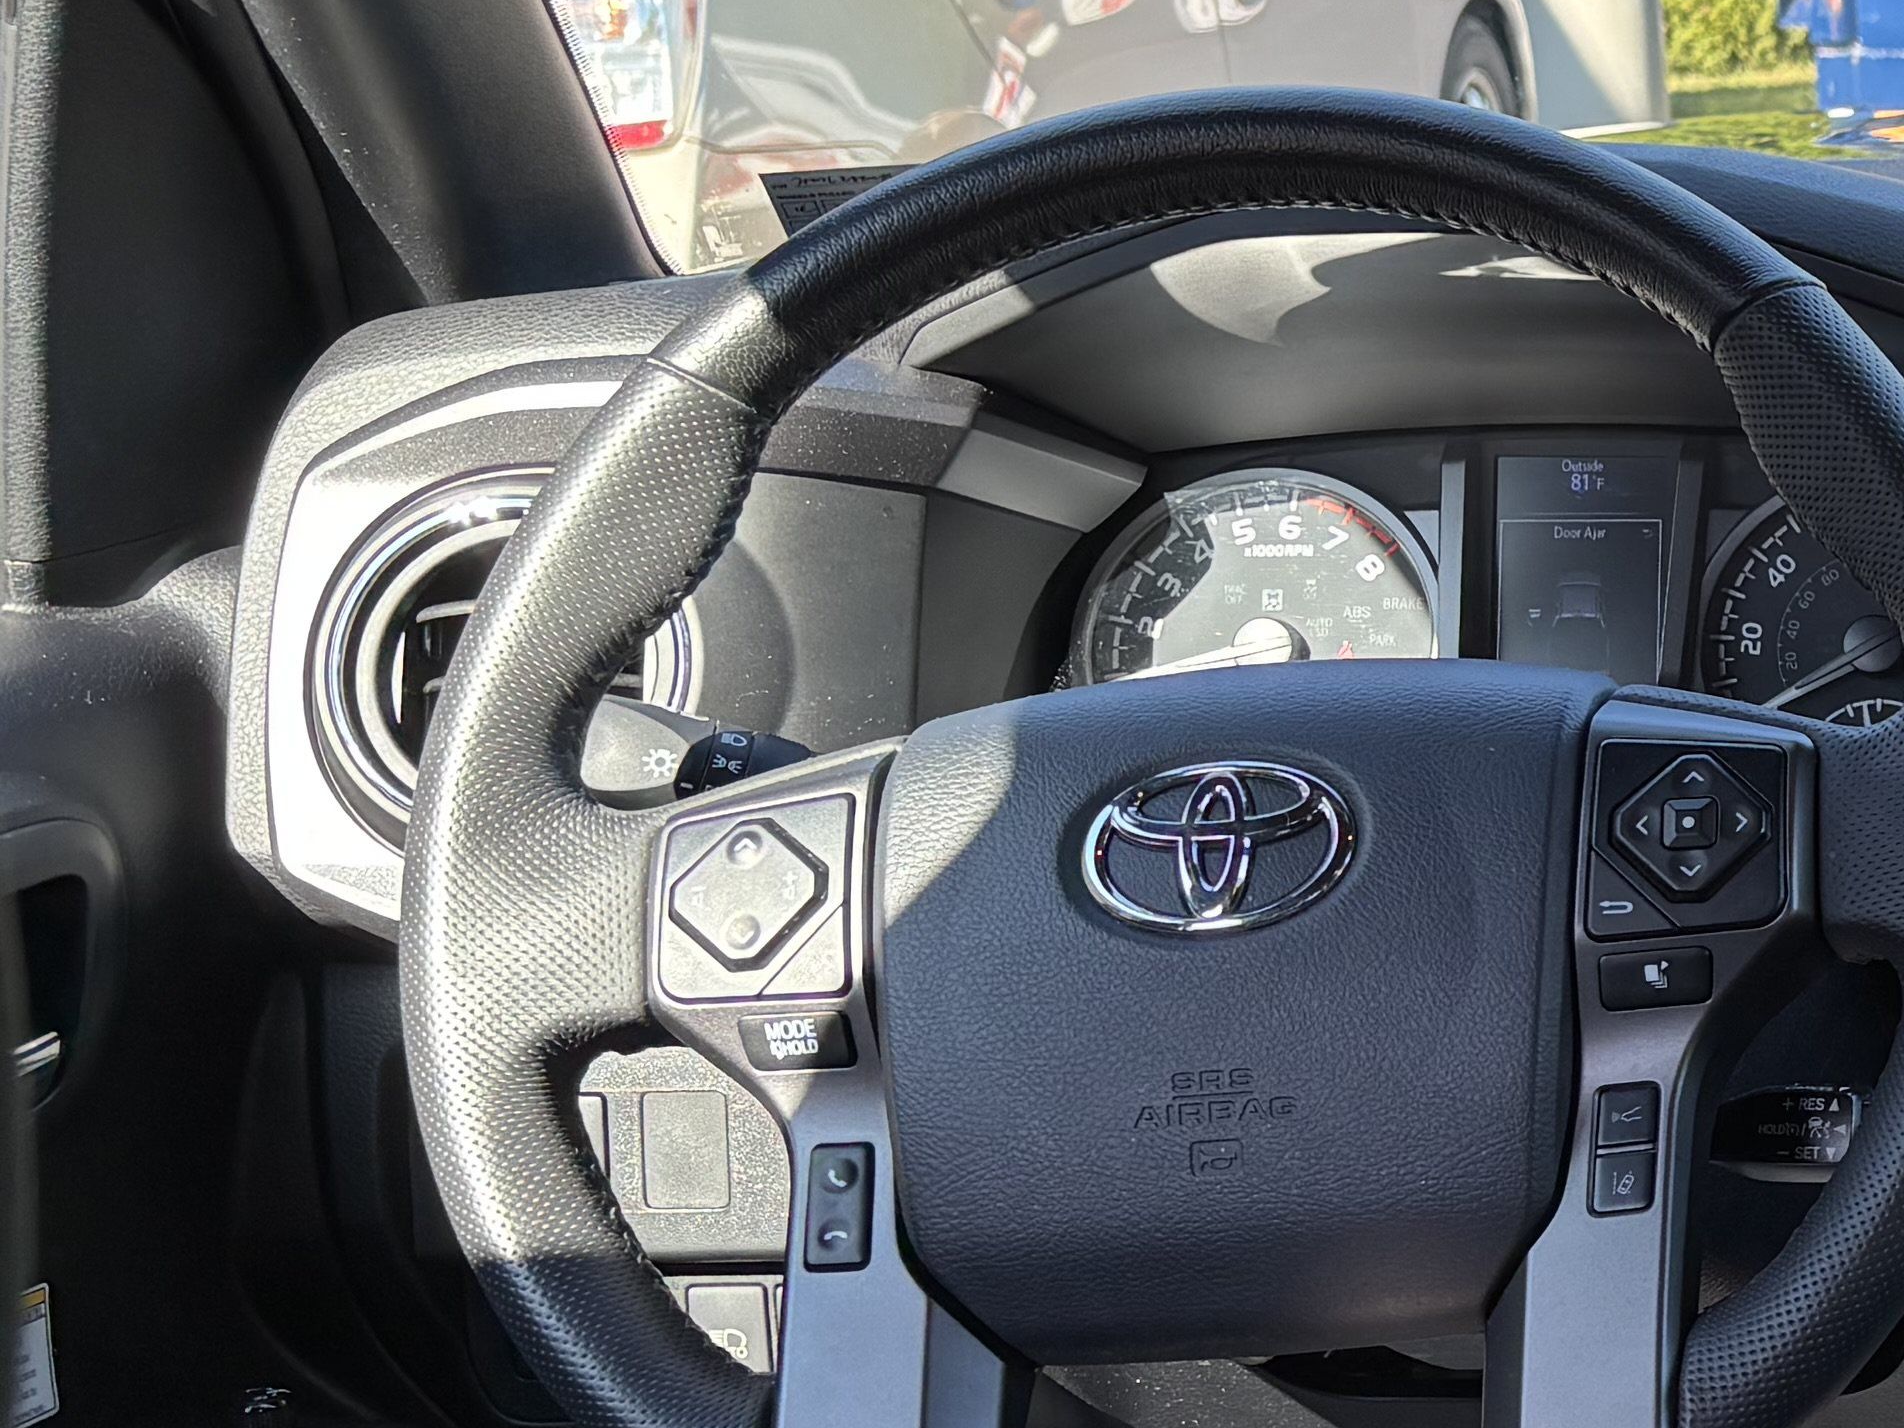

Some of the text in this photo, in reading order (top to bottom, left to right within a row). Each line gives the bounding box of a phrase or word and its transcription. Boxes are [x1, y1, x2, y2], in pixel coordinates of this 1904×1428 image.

[1560, 459, 1605, 474] Outside
[1230, 517, 1257, 547] 5
[1278, 514, 1304, 541] 6
[1321, 523, 1350, 552] 7
[1553, 524, 1607, 543] Door Ajar
[1185, 538, 1217, 565] 4
[1354, 552, 1387, 582] 8
[1766, 552, 1799, 590] 40
[1382, 597, 1426, 611] BRAKE
[1797, 589, 1818, 612] 60
[1342, 605, 1372, 620] ABS
[1368, 633, 1398, 647] PARK
[1740, 621, 1763, 656] 20
[1785, 618, 1802, 642] 40
[1785, 650, 1799, 672] 20
[763, 1019, 818, 1042] MODE
[1168, 1068, 1255, 1095] SRS
[1132, 1094, 1299, 1131] AIRBAG
[1798, 1096, 1826, 1113] RES
[1793, 1145, 1822, 1161] SET
